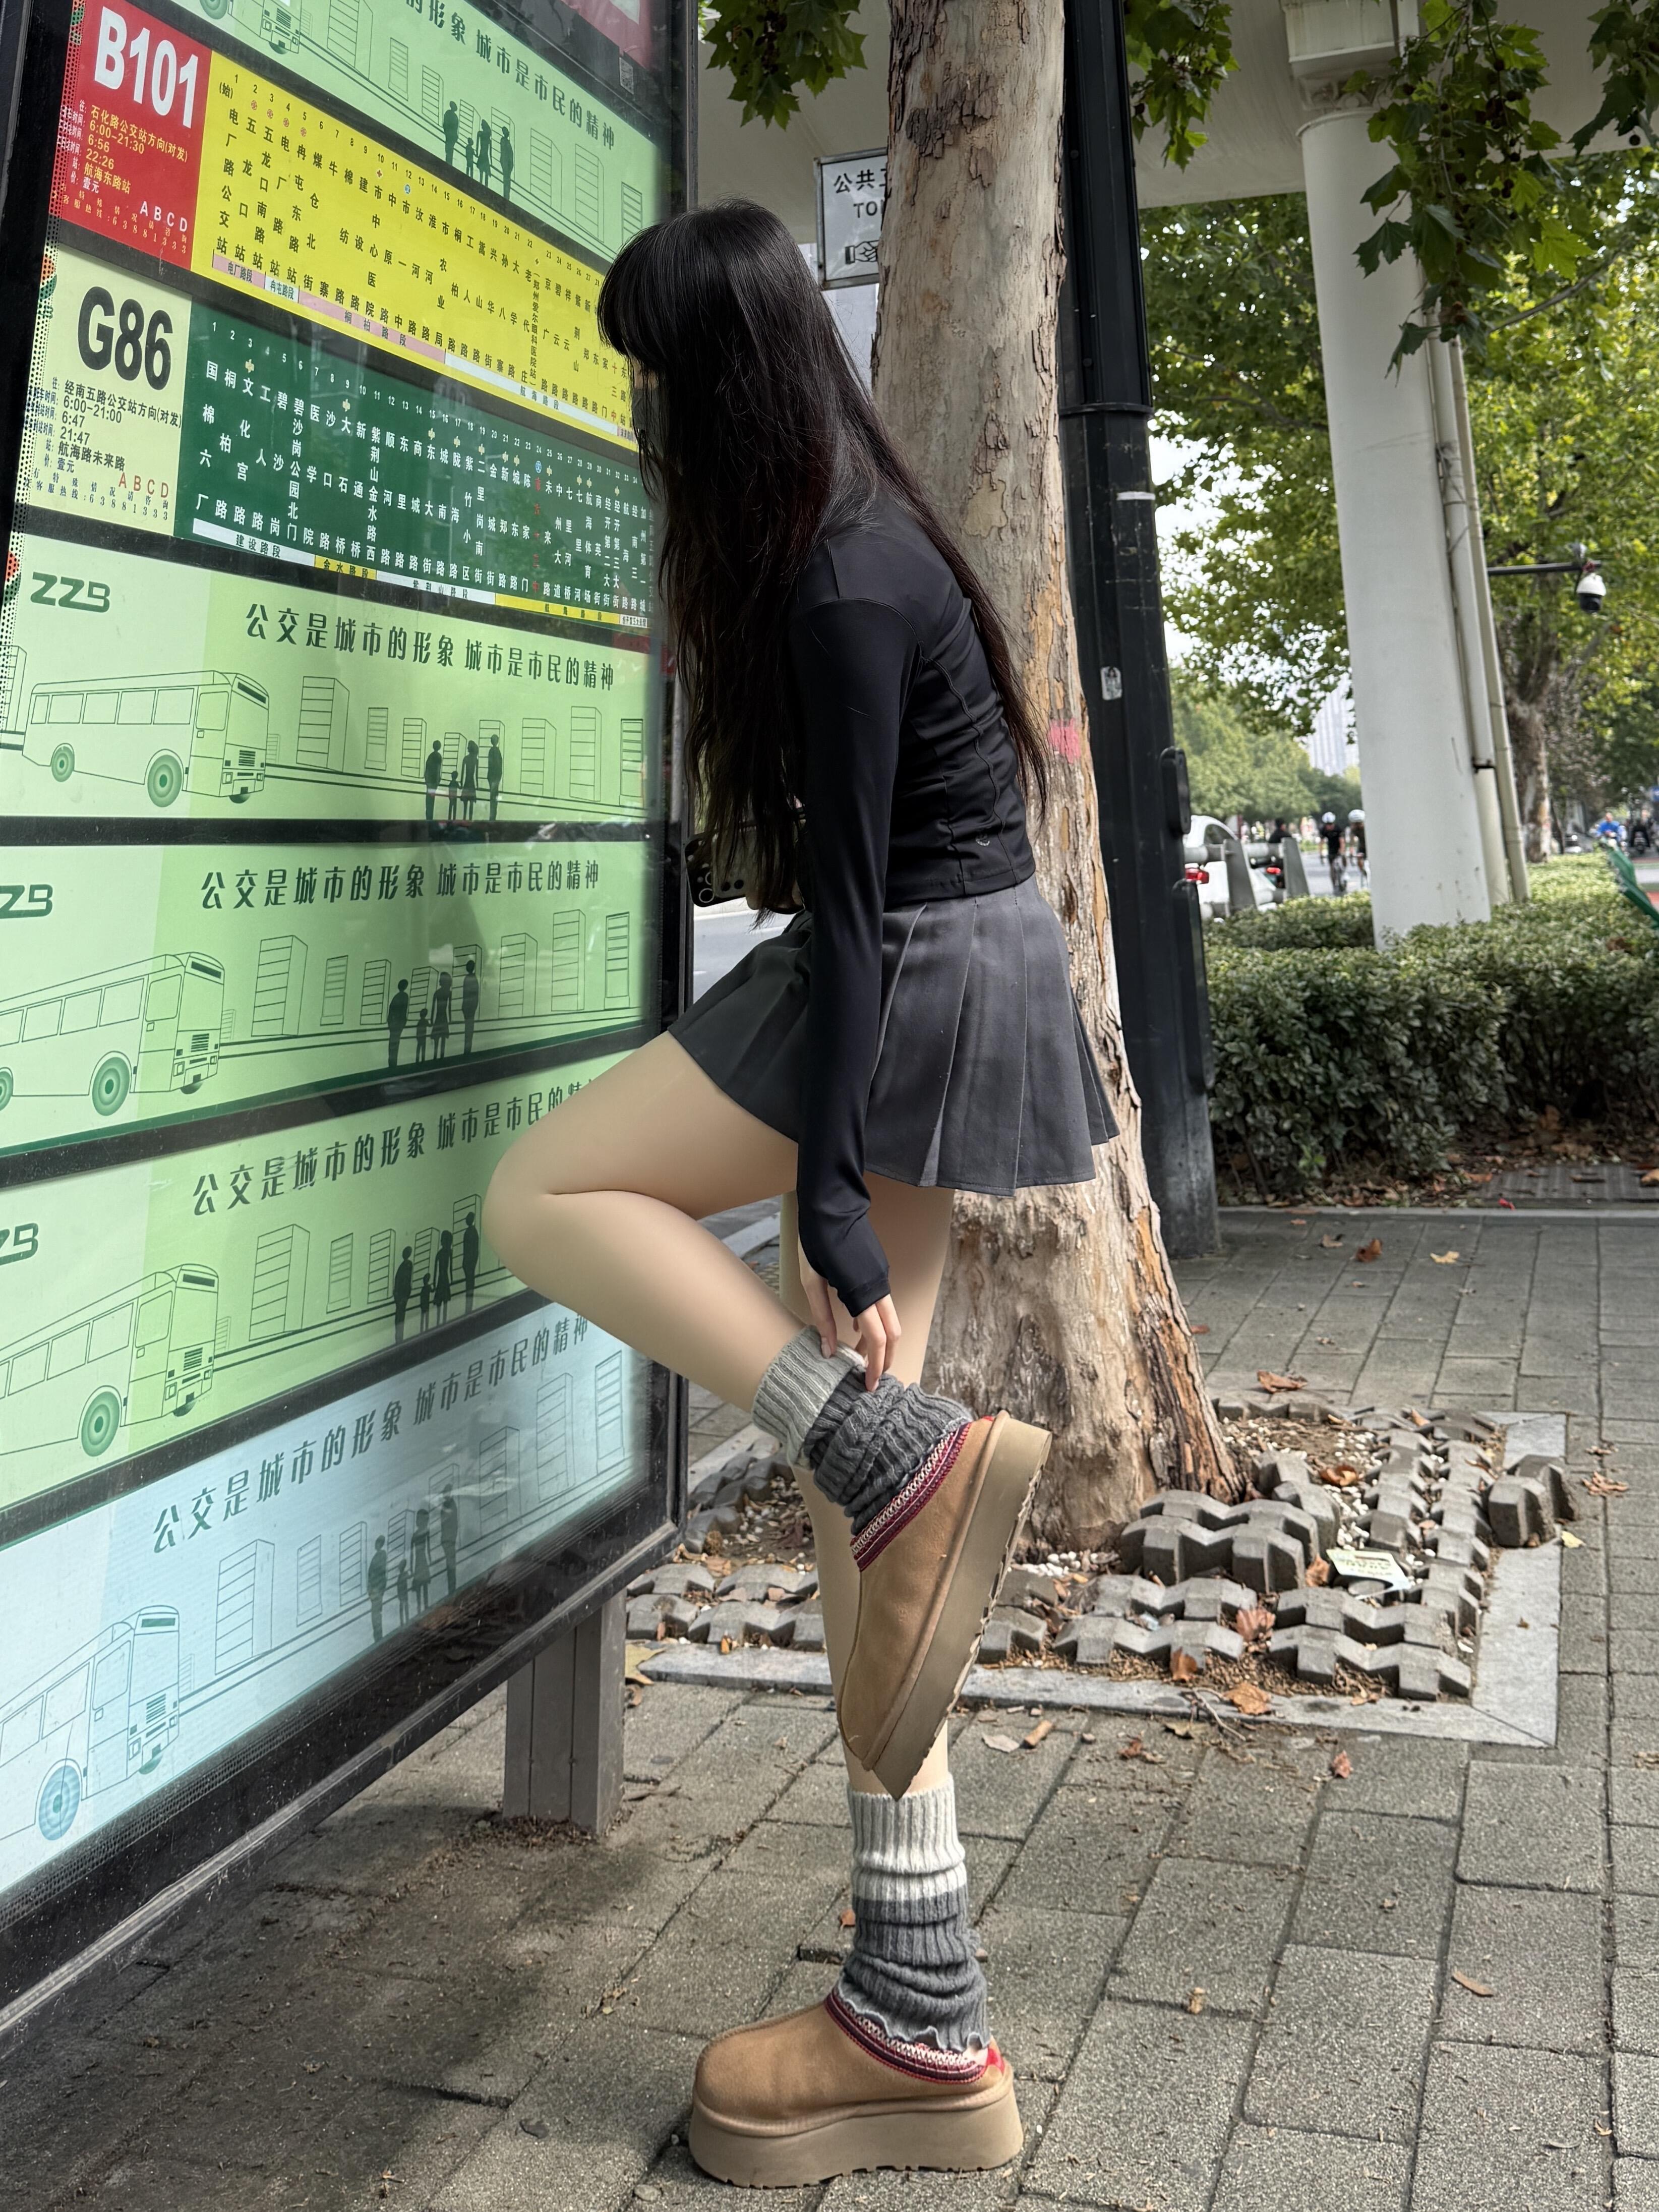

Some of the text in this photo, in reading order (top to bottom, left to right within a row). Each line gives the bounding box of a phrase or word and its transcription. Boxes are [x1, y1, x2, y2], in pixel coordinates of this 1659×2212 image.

[94, 6, 199, 130] B101
[219, 82, 233, 99] (始)
[476, 29, 615, 150] 城市是市民的精神
[82, 177, 100, 194] 壹元
[84, 162, 132, 194] 航海东路站
[85, 148, 114, 170] 22:26
[88, 135, 110, 153] 6:56
[89, 120, 145, 154] 6:00-21:30
[90, 105, 188, 162] 石化路公交站方向(对发)
[216, 108, 239, 255] 电厂路公交站
[234, 117, 257, 262] 五龙口站
[235, 74, 238, 83] 1
[254, 85, 258, 93] 2
[270, 93, 274, 102] 3
[286, 103, 290, 111] 4
[303, 112, 307, 121] 5
[320, 121, 323, 129] 6
[335, 130, 339, 138] 7
[350, 138, 354, 146] 8
[364, 145, 368, 154] 9
[378, 153, 384, 163] 10
[392, 161, 397, 171] 11
[405, 169, 411, 179] 12
[419, 177, 424, 186] 13
[432, 184, 437, 194] 14
[444, 191, 450, 200] 15
[457, 199, 463, 208] 16
[470, 206, 476, 215] 17
[481, 212, 486, 221] 18
[493, 219, 498, 227] 19
[504, 225, 510, 235] 20
[514, 232, 520, 241] 21
[527, 239, 532, 249] 22
[834, 168, 887, 194] 公共
[139, 201, 188, 232] A B C D
[252, 126, 274, 270] 五龙口南路站
[270, 136, 290, 277] 电厂路站
[286, 144, 307, 284] 冉屯东路站
[304, 151, 323, 291] 煤仓北街
[319, 161, 338, 298] 牛寨
[335, 168, 353, 305] 棉纺路
[350, 176, 369, 312] 建设路
[365, 185, 383, 317] 市中心医院
[379, 193, 397, 324] 中原路
[394, 200, 411, 329] 市一中
[407, 207, 424, 336] 汝河路
[421, 213, 437, 341] 淮河路
[434, 221, 450, 347] 市农业局
[447, 227, 462, 353] 桐柏路
[460, 235, 475, 358] 工人路
[78, 286, 174, 391] G86
[212, 322, 216, 332] 1
[230, 330, 235, 340] 2
[248, 338, 253, 348] 3
[265, 346, 270, 355] 4
[282, 353, 287, 363] 5
[299, 360, 303, 370] 6
[315, 367, 319, 376] 7
[330, 373, 335, 383] 8
[345, 379, 350, 388] 9
[360, 385, 367, 395] 10
[374, 390, 380, 400] 11
[388, 396, 395, 405] 12
[402, 401, 409, 410] 13
[416, 405, 423, 415] 14
[429, 409, 436, 419] 15
[442, 414, 449, 424] 16
[455, 418, 461, 427] 17
[467, 422, 473, 431] 18
[480, 426, 486, 435] 19
[491, 430, 497, 439] 20
[503, 434, 509, 443] 21
[514, 438, 520, 447] 22
[57, 457, 75, 474] 壹元
[58, 441, 126, 472] 航海路未来路
[60, 426, 90, 445] 21:47
[62, 411, 85, 428] 6:47
[64, 395, 123, 424] 6:00-21:00
[65, 379, 183, 429] 经南五路公交站方向(对发)
[196, 360, 218, 510] 国棉六厂
[215, 369, 236, 520] 桐柏路
[234, 378, 254, 526] 文化宫路
[252, 385, 271, 532] 工人路
[270, 391, 288, 537] 碧沙岗
[118, 472, 169, 498] A B C D
[287, 398, 305, 541] 碧沙岗公园北门
[304, 403, 320, 546] 医学院
[319, 410, 336, 551] 沙口路
[335, 416, 351, 555] 大石桥
[350, 421, 367, 559] 新通桥
[366, 426, 381, 562] 紫荆山金水路西
[380, 431, 395, 566] 顺河路
[395, 436, 409, 569] 东里路
[409, 440, 423, 572] 商城路
[423, 444, 436, 574] 东大街
[436, 448, 449, 577] 城南路
[475, 460, 486, 584] 二里岗南街
[509, 470, 520, 591] 城东路
[30, 571, 111, 614] ZZB
[235, 534, 280, 558] 建设路段
[543, 480, 553, 597] 未来路
[553, 483, 563, 599] 中州大道
[564, 487, 573, 601] 七里河桥
[574, 490, 583, 602] 七里河
[246, 603, 614, 691] 公交是城市的形象 城市是市民的精神
[0, 884, 53, 919] ZB
[201, 859, 599, 909] 公交是城市的形象 城市是市民的精神
[193, 1078, 593, 1216] 公交是城市的形象 城市是市民的
[153, 1312, 588, 1554] 公交是城市的形象 城市是市民的精神
